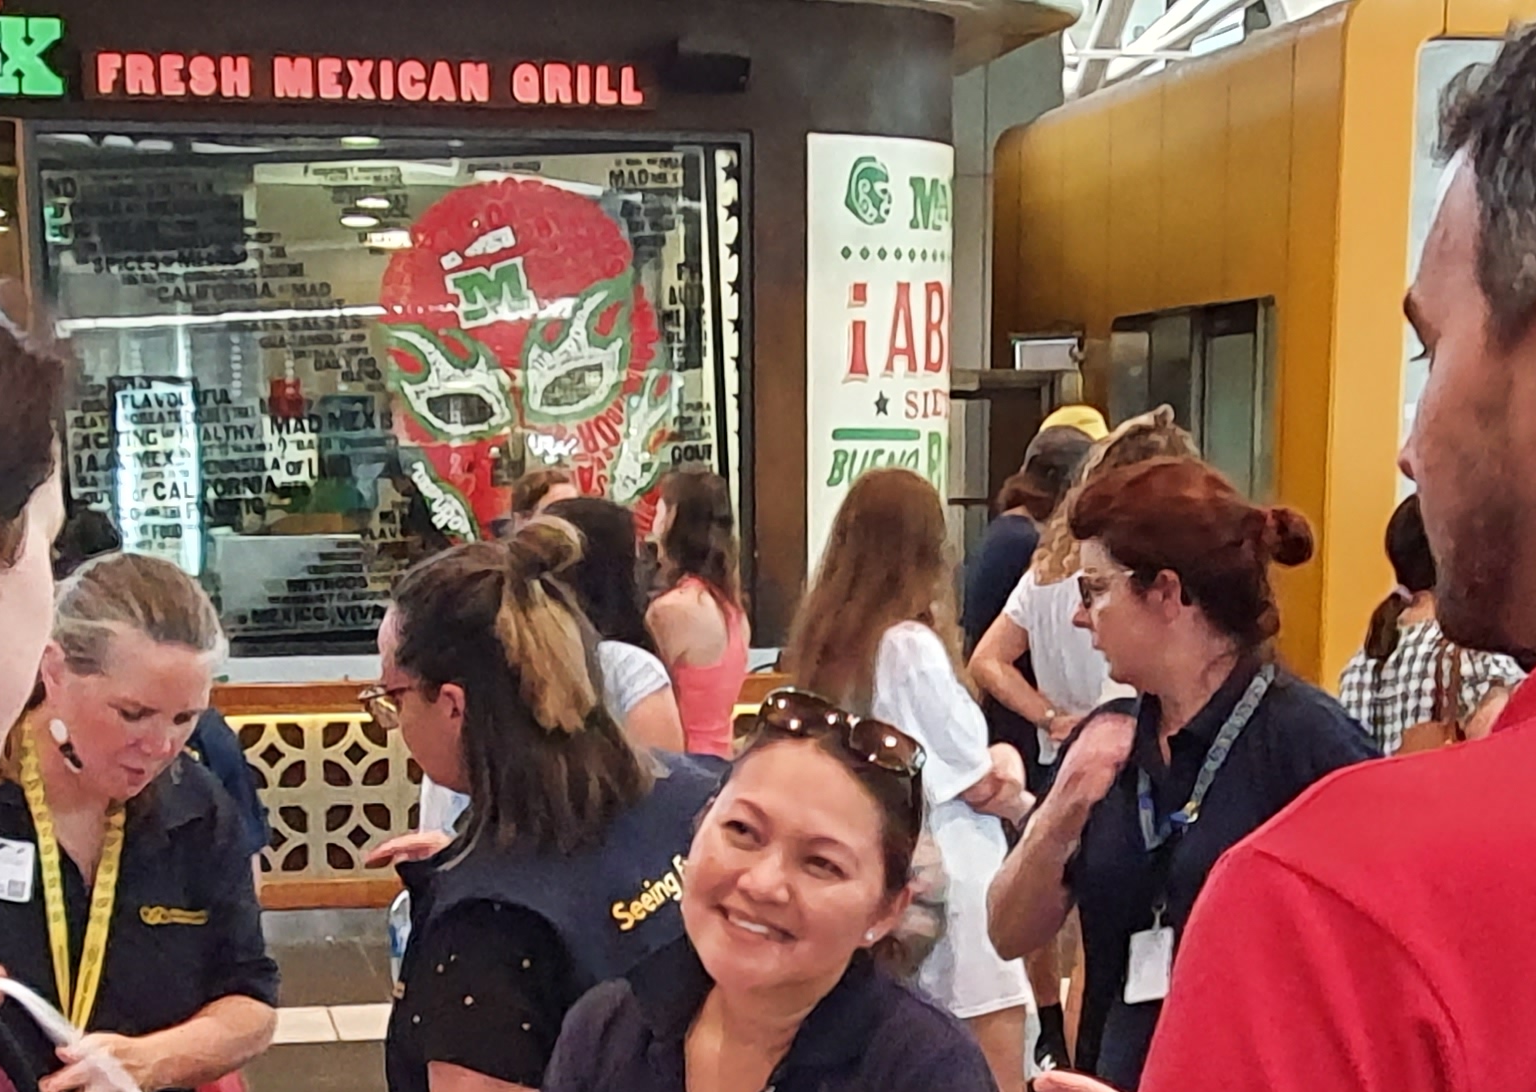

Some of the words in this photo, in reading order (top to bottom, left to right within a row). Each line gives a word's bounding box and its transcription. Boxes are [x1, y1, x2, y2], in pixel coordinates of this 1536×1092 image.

[97, 53, 251, 98] FRESH
[273, 56, 489, 102] MEXICAN
[512, 63, 644, 105] GRILL
[612, 871, 683, 931] Seeing
